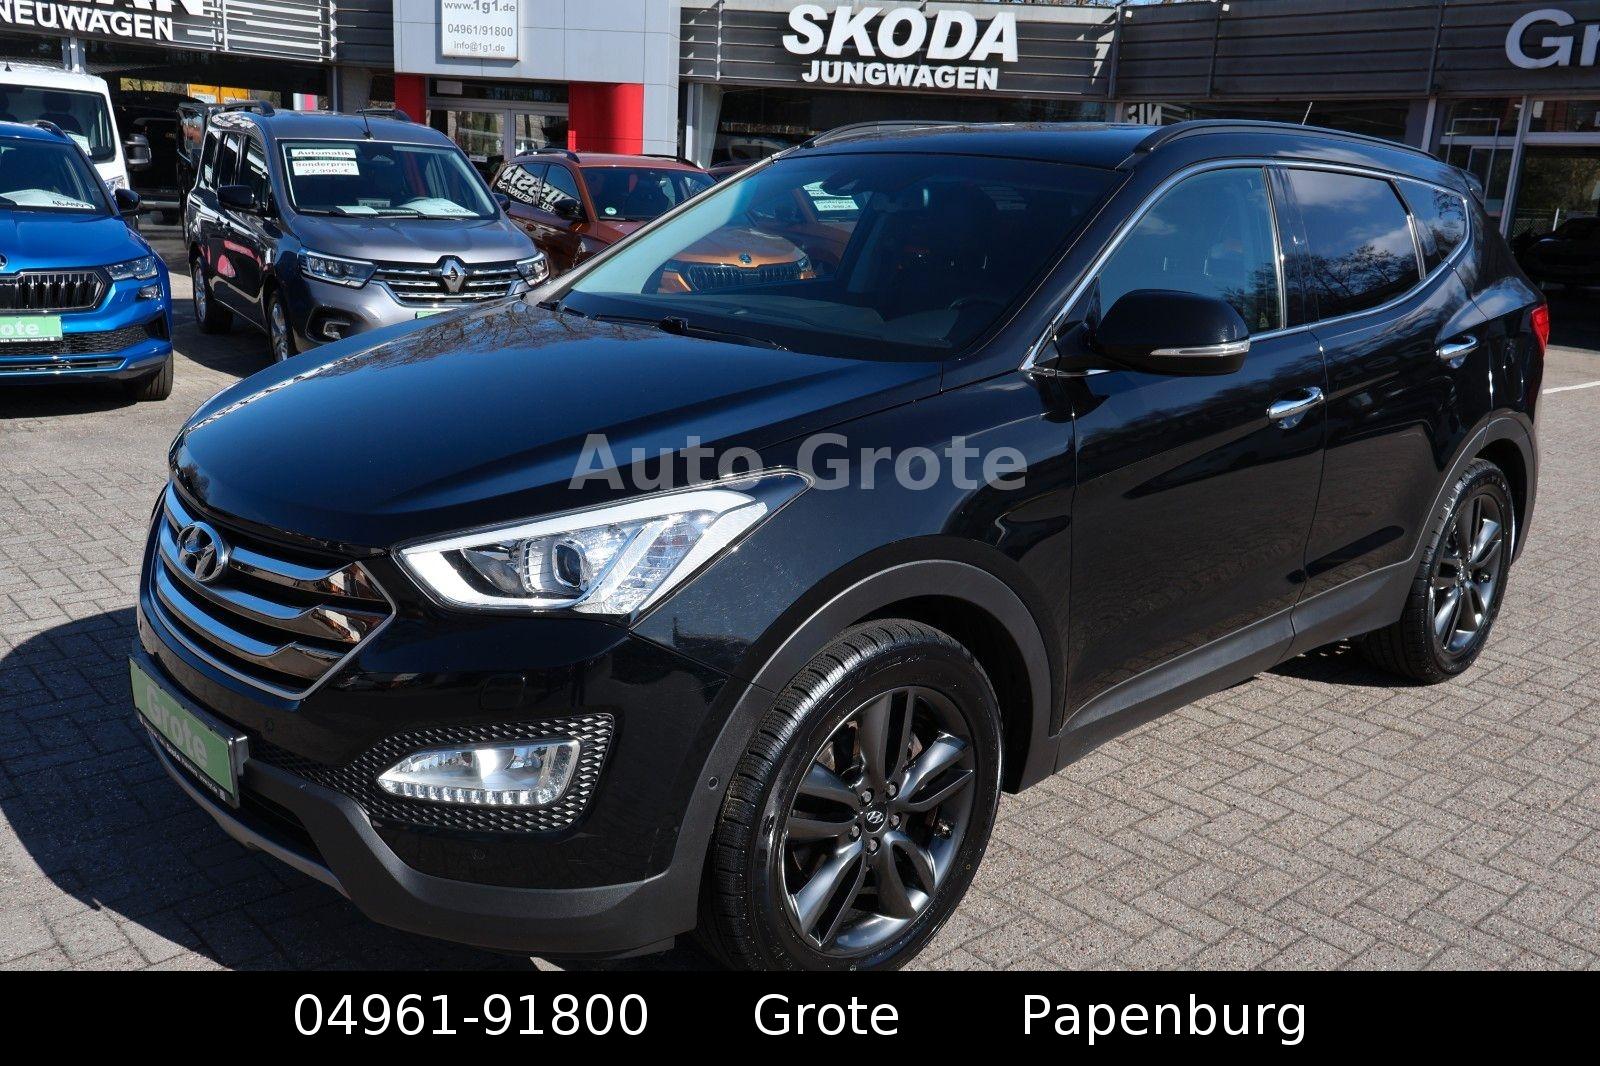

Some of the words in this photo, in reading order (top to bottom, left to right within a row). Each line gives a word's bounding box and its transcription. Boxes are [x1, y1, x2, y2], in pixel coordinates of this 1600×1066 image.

[0, 0, 173, 41] NEUWAGEN
[444, 0, 516, 14] www.1g1.de
[447, 23, 513, 37] 04961/91800
[453, 41, 505, 52] info@1g1.de
[782, 5, 1018, 62] SKODA
[1505, 8, 1600, 69] Gr
[802, 60, 998, 90] JUNGWAGEN
[146, 683, 208, 767] Grote
